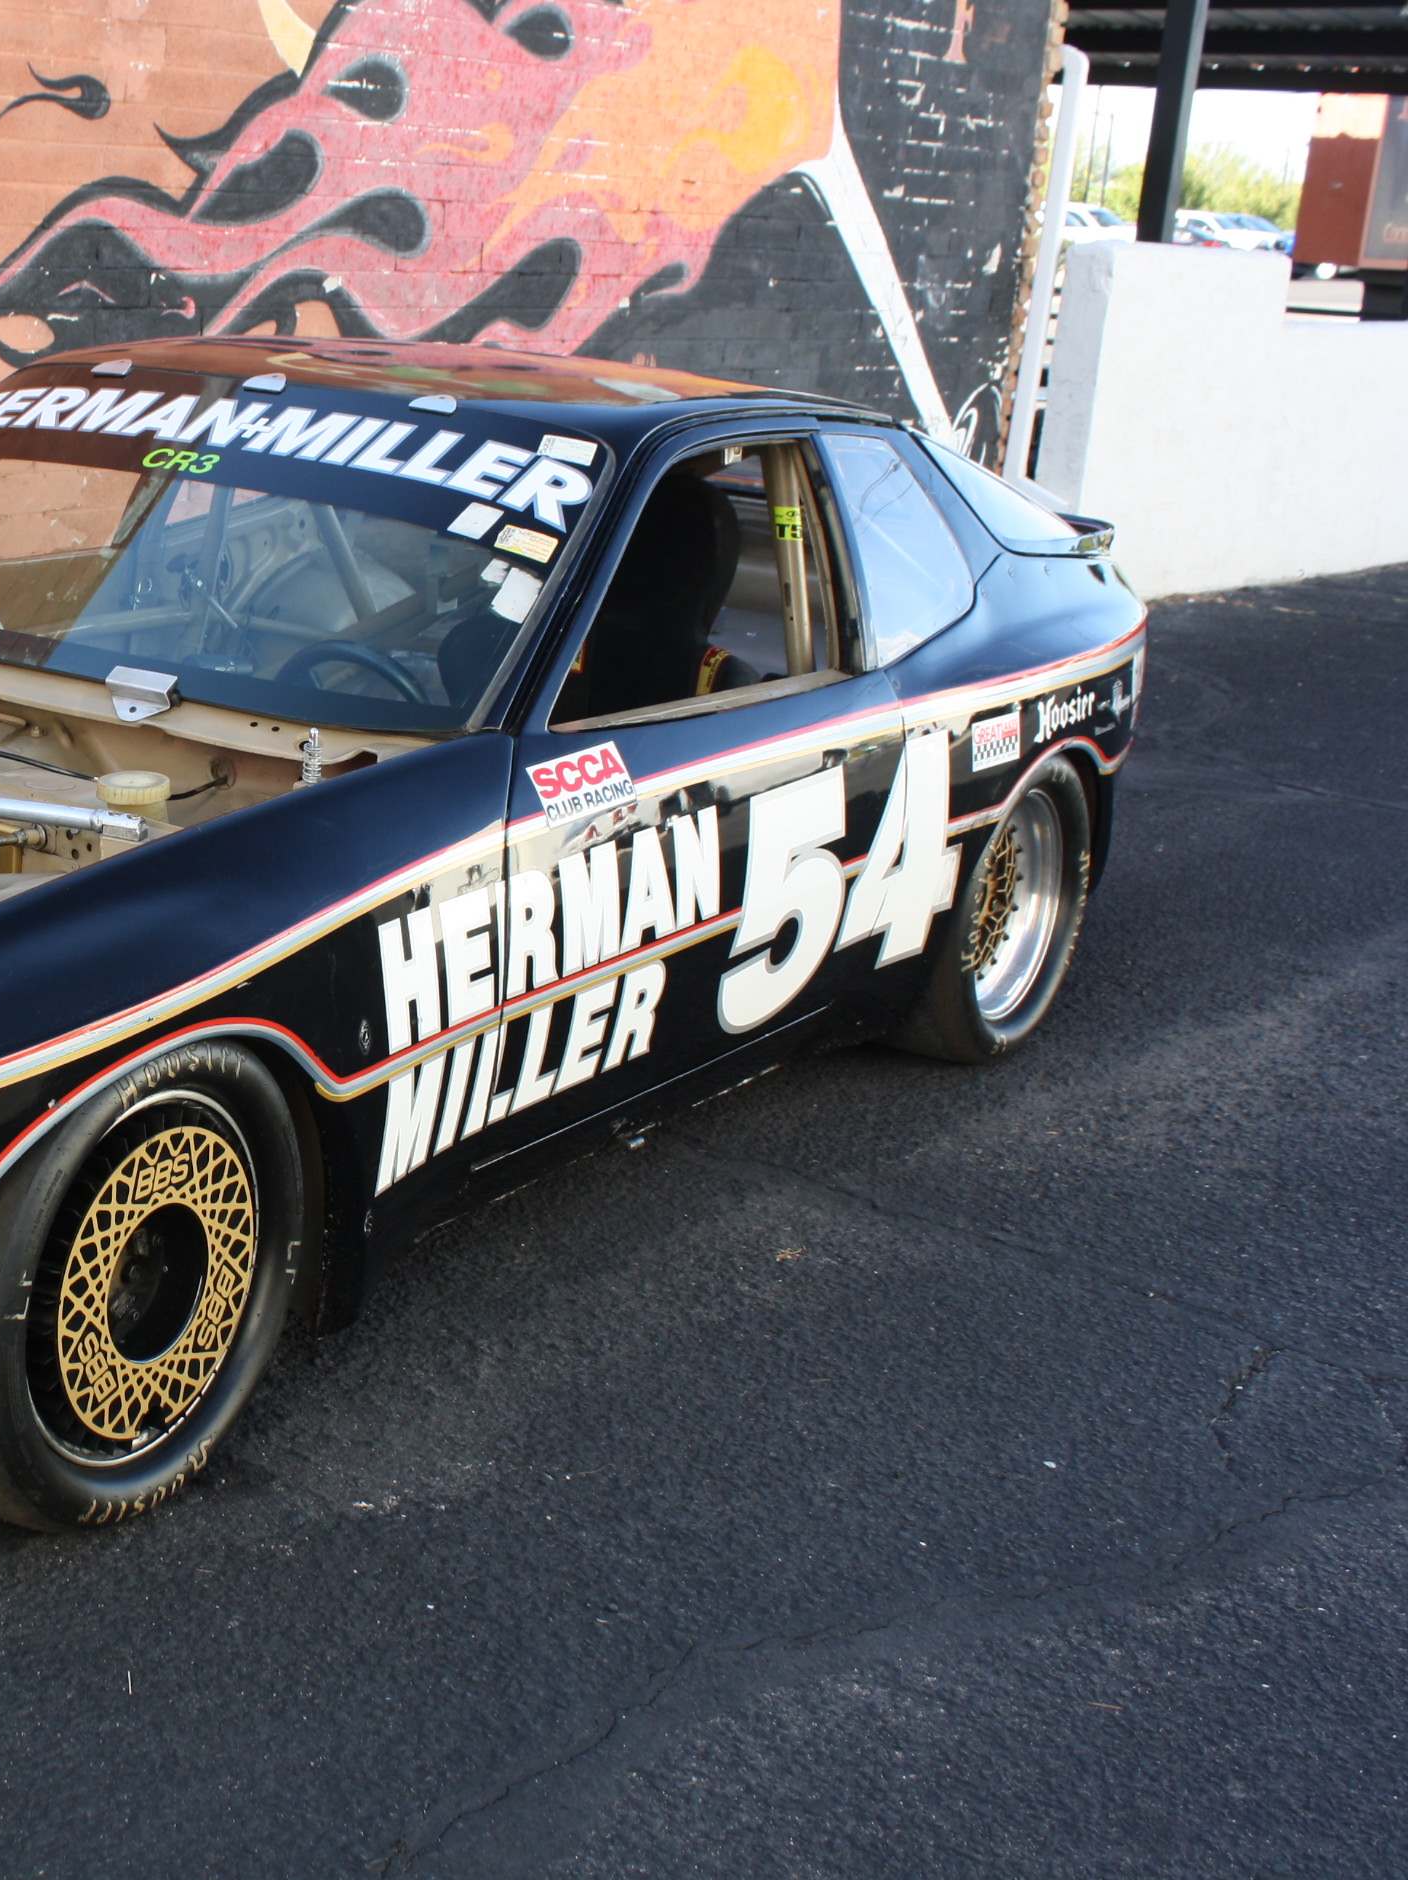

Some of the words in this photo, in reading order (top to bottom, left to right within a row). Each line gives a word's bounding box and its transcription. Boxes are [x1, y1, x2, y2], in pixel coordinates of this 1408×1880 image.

[142, 448, 220, 474] CR3
[1034, 686, 1096, 744] Hoosier
[532, 748, 626, 799] SCCA
[546, 796, 583, 821] CLUB
[583, 779, 634, 809] RACING
[717, 729, 963, 1034] 54
[378, 805, 720, 1055] HERMAN
[375, 958, 667, 1196] MILLER
[135, 1153, 190, 1200] BBS
[197, 1264, 237, 1350] BBS
[76, 1331, 117, 1403] BBS
